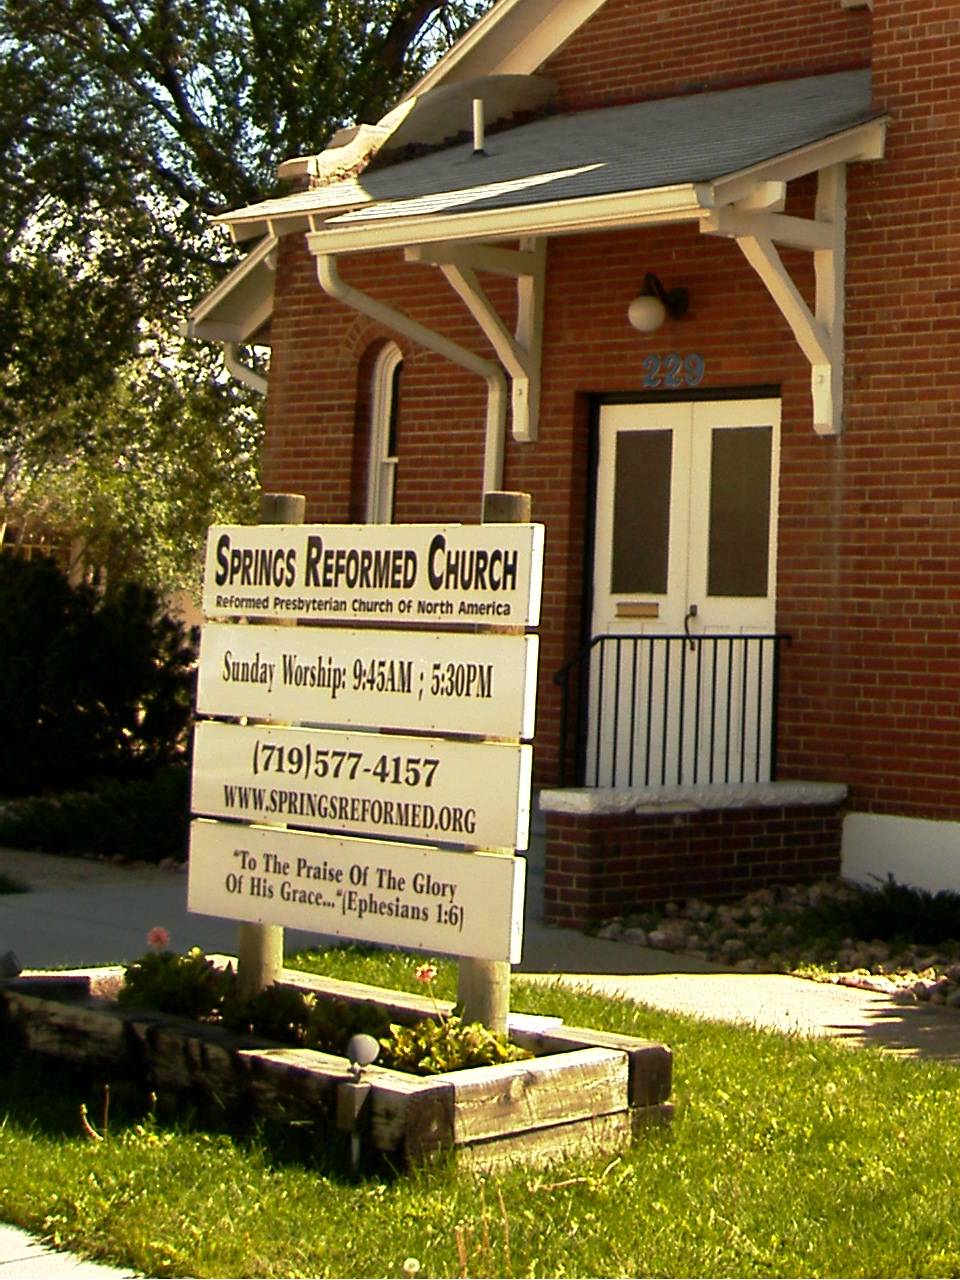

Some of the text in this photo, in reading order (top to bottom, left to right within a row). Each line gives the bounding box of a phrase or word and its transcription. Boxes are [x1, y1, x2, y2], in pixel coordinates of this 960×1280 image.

[643, 352, 705, 387] 229
[215, 533, 519, 592] SPRINGS REFORMED CHURCH
[215, 595, 512, 616] Reformed Presbyterian Church Of North America
[223, 650, 276, 693] Sunday
[282, 653, 347, 699] Worship:
[352, 658, 413, 694] 9:45AM
[431, 663, 494, 699] 5:30PM
[252, 740, 440, 788] (719)577-4157
[224, 784, 477, 834] WWW.SPRINGSREFORMED.ORG
[263, 852, 290, 876] The
[296, 857, 343, 883] Praise
[349, 864, 369, 886] Of
[376, 868, 406, 892] The
[412, 872, 457, 904] Glory
[225, 873, 244, 894] Of
[250, 876, 275, 899] His
[436, 903, 464, 933] 1:6)
